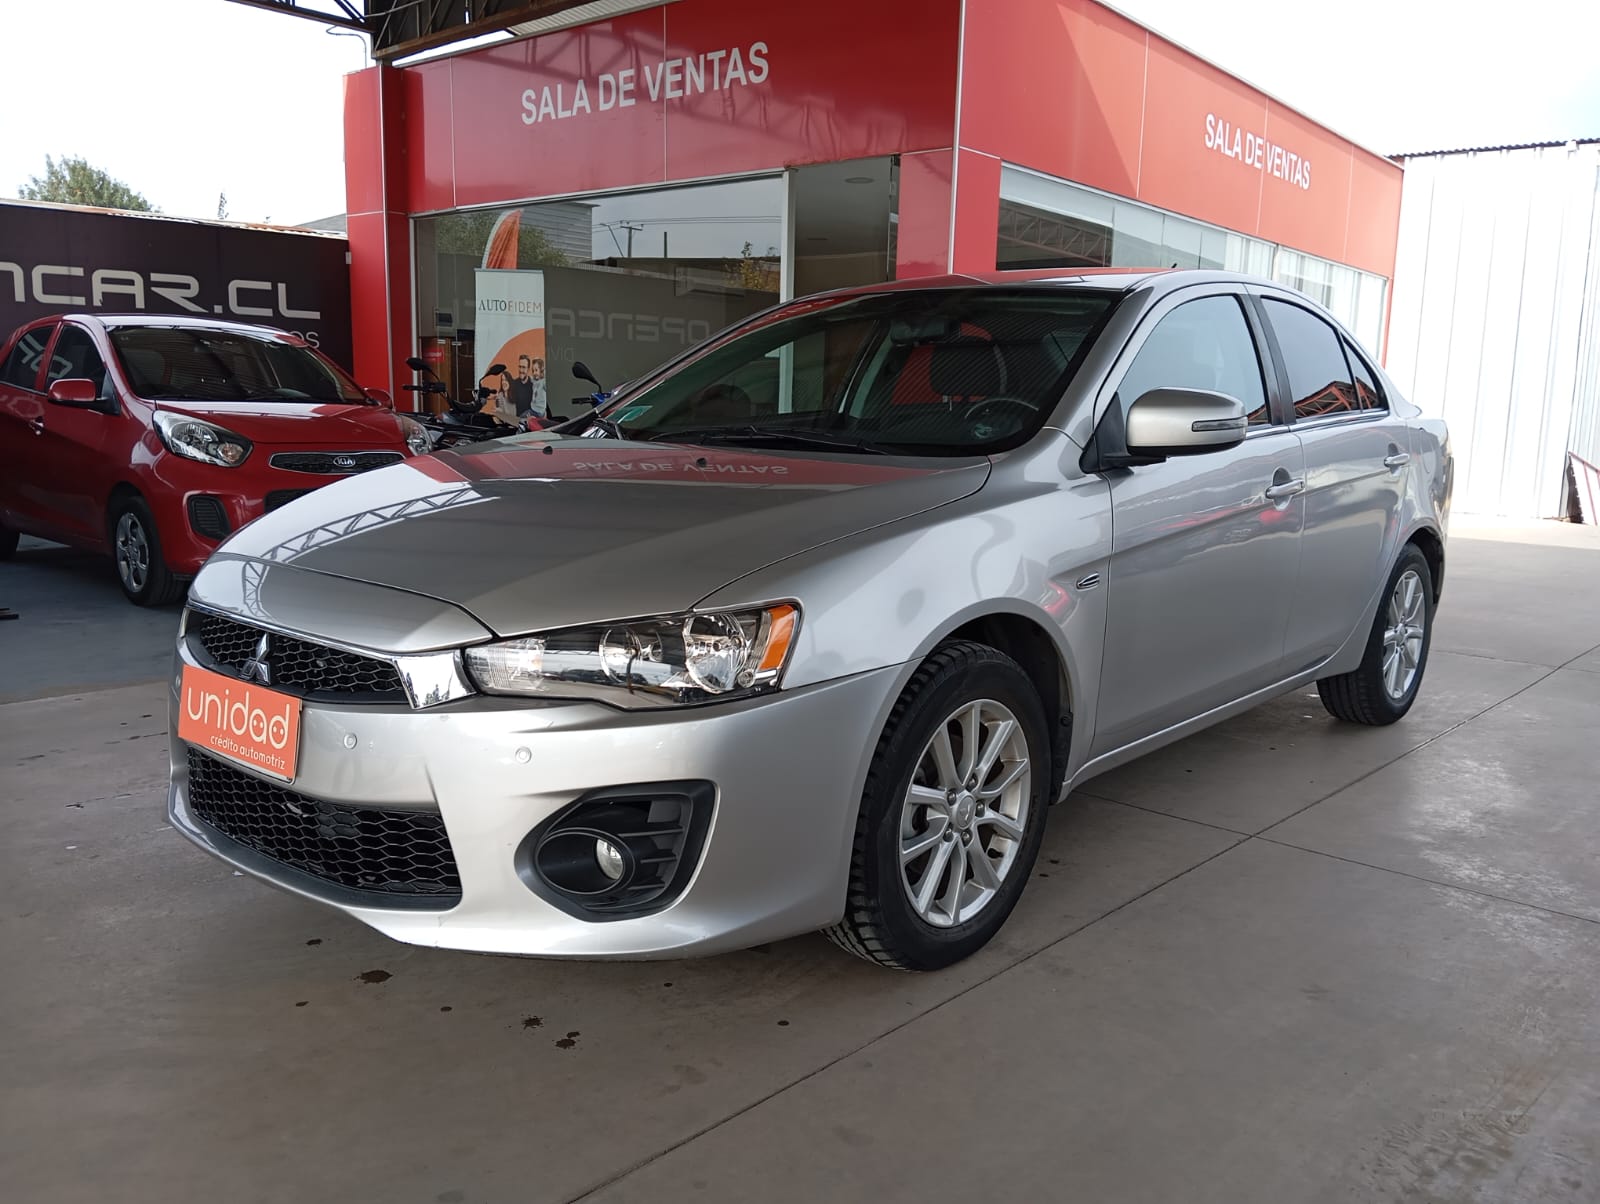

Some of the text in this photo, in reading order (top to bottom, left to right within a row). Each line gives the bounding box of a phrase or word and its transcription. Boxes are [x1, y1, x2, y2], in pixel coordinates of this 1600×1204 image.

[521, 41, 769, 125] SALA DE VENTAS
[1205, 113, 1310, 190] SALA DE VENTAS
[478, 299, 542, 313] AUTOFIDEM
[187, 687, 290, 749] unidad
[210, 733, 286, 770] crédito automotriz
